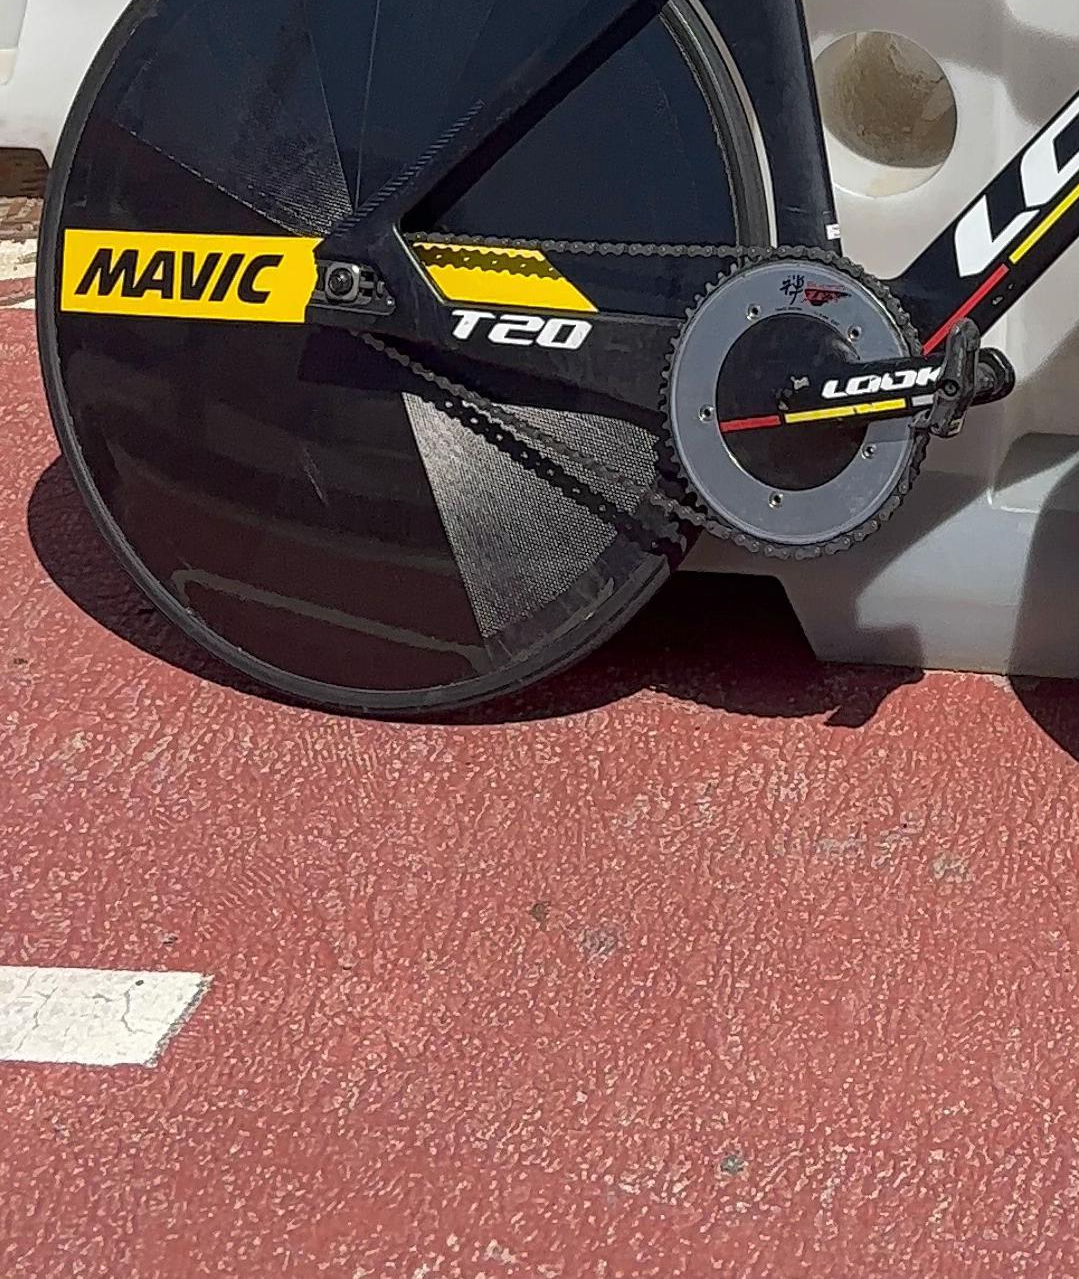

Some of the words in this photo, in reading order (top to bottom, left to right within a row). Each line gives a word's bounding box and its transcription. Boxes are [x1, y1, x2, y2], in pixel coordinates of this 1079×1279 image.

[74, 247, 284, 304] MAVIC
[451, 309, 593, 350] T20
[821, 366, 943, 399] LOOK
